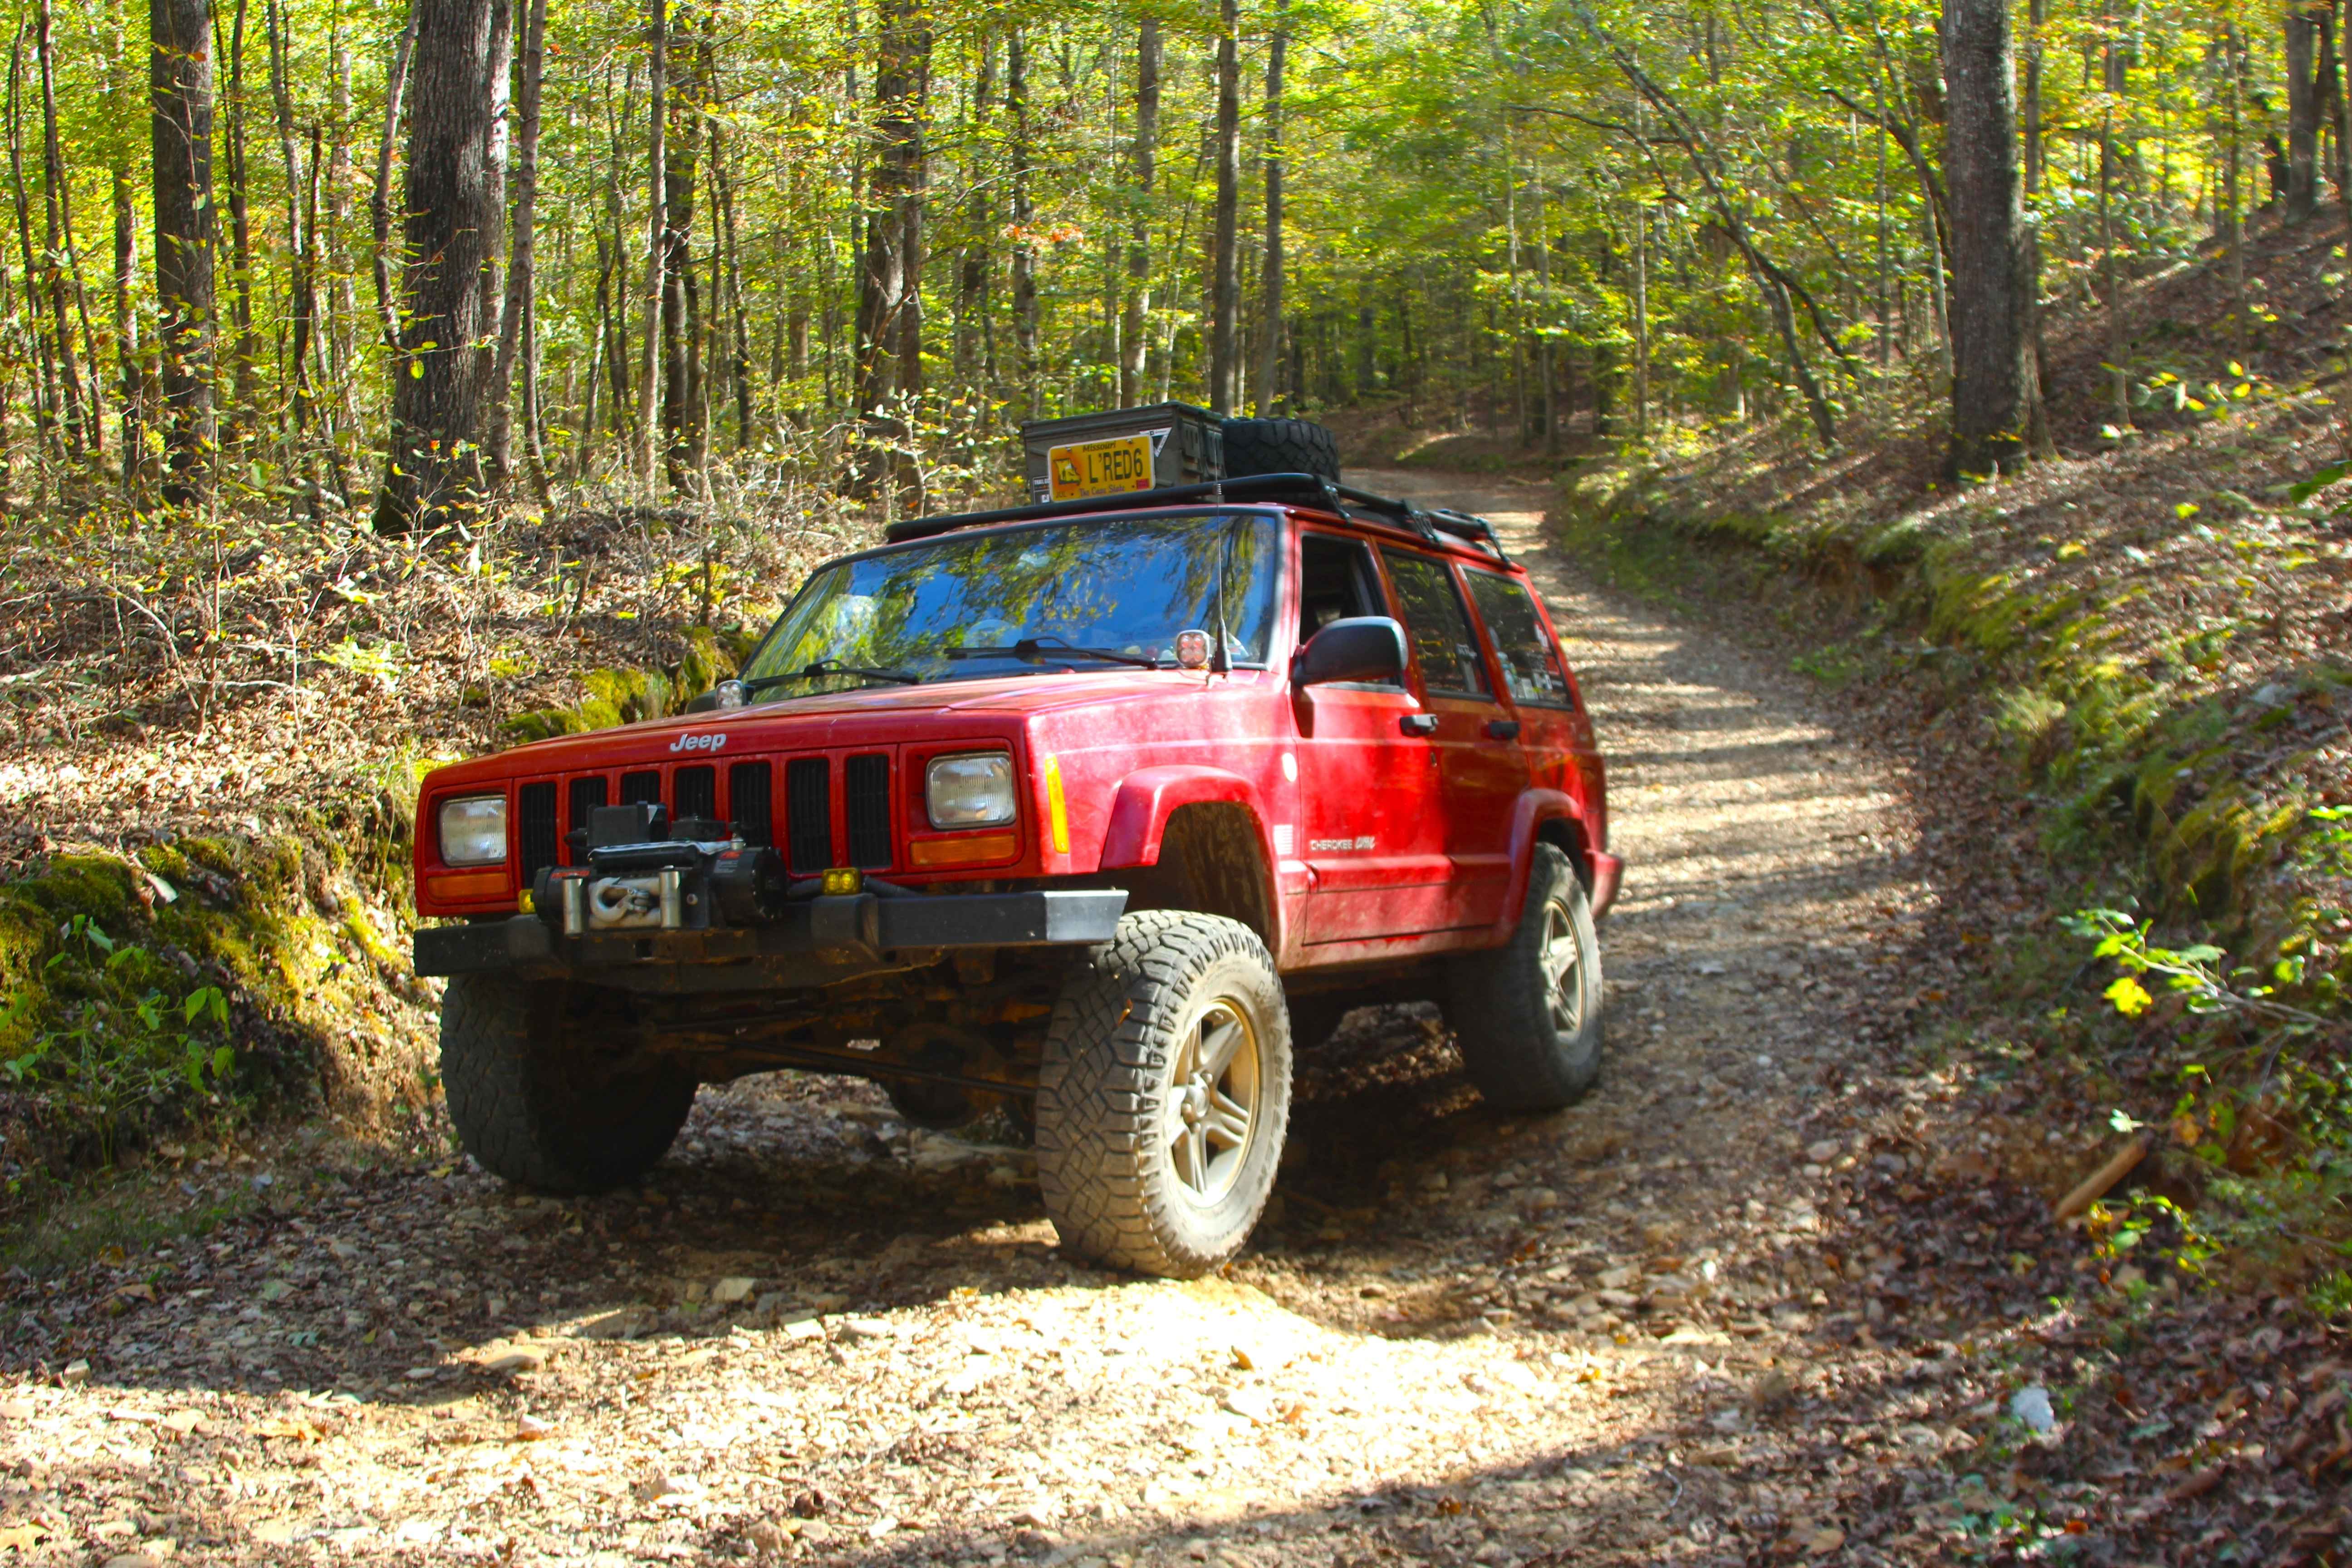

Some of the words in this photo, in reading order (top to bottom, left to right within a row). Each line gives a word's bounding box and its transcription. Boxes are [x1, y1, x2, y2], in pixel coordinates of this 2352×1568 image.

[1083, 441, 1116, 452] Missouri
[1088, 448, 1143, 483] L'RED6
[670, 733, 726, 751] Jeep
[1310, 839, 1352, 850] CHEROKEE
